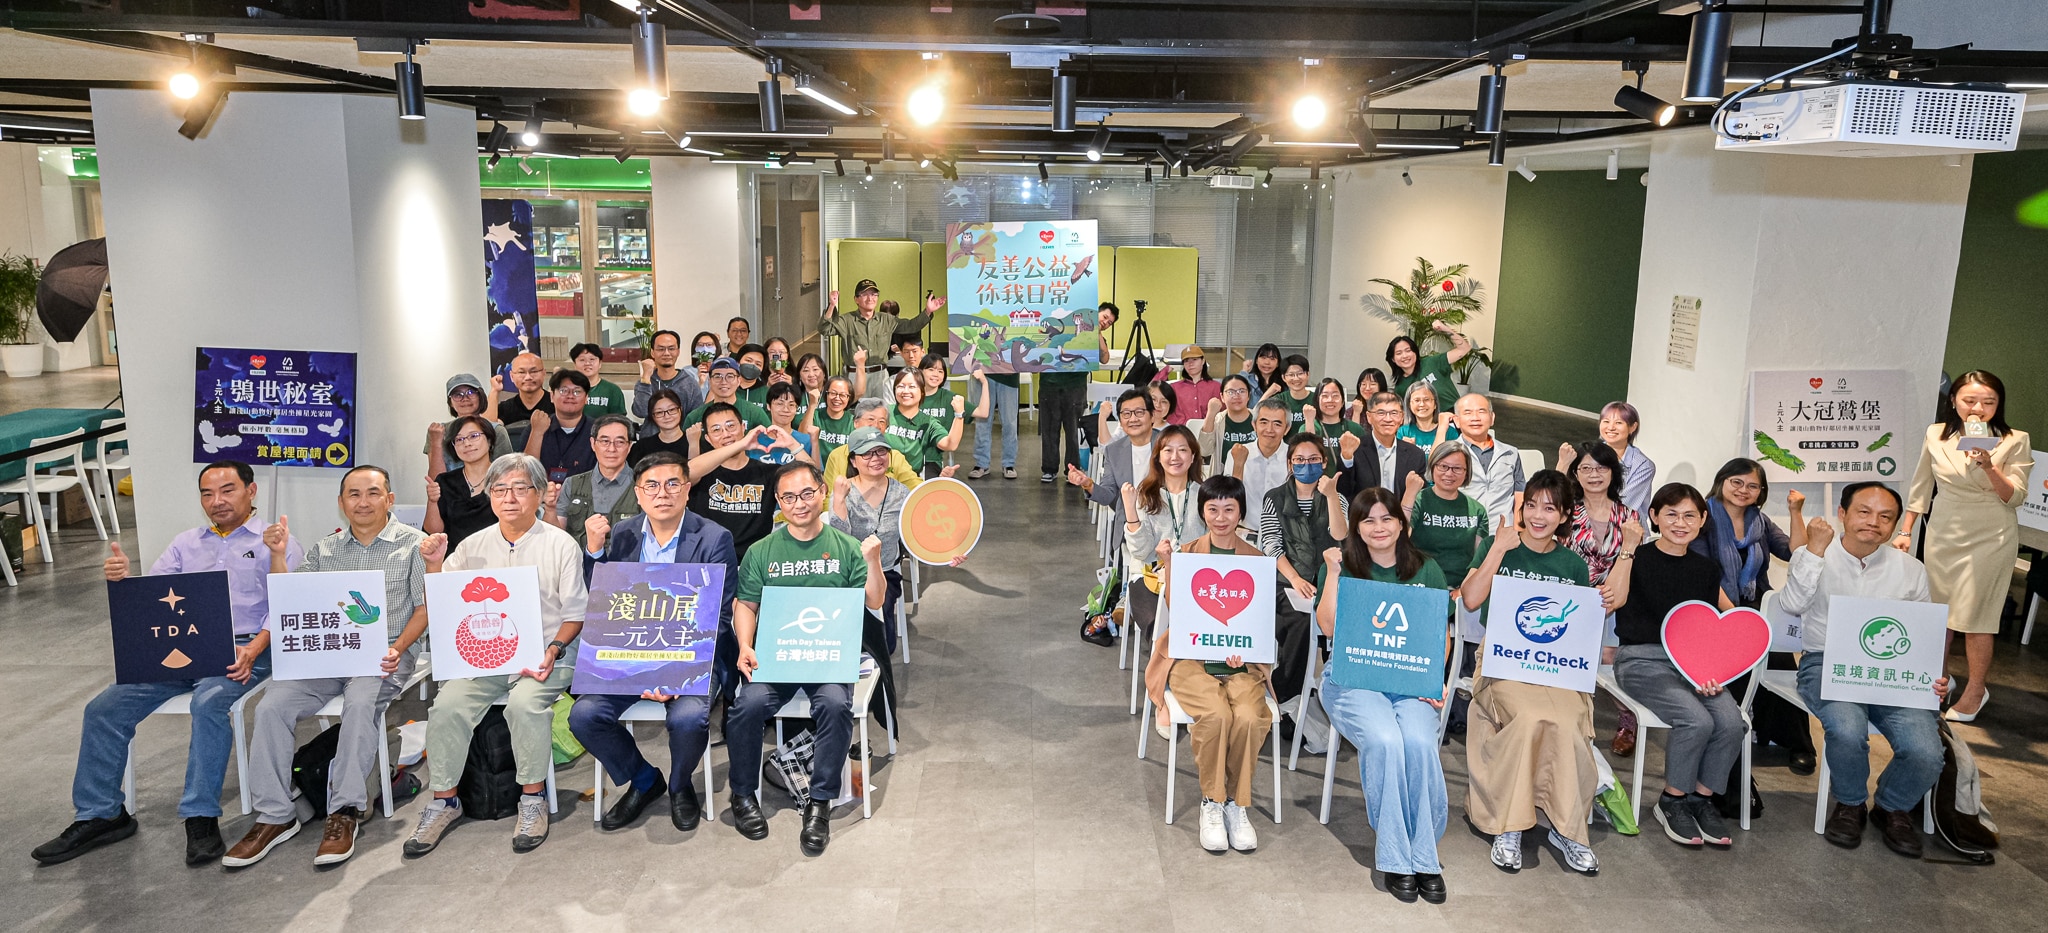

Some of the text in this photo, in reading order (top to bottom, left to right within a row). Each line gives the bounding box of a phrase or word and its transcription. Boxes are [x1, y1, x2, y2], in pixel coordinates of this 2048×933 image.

[977, 255, 1071, 281] 友善公益
[976, 281, 1070, 305] 你我日常
[214, 379, 223, 414] 1元入主
[1790, 400, 1881, 421] 大冠鷲堡
[257, 445, 322, 459] 賞屋裡面請
[1816, 461, 1874, 472] 賞屋裡面請
[1432, 514, 1478, 528] 自然環資
[782, 559, 840, 576] 自然環資
[1198, 584, 1248, 608] 把愛找回來
[607, 592, 699, 621] 淺山居
[151, 624, 199, 638] TDA
[281, 612, 340, 631] 阿里磅
[282, 633, 361, 652] 生態農場
[602, 625, 695, 647] 一元入主
[799, 639, 814, 647] Day
[815, 638, 841, 646] Taiwan
[1372, 632, 1406, 648] TNF
[776, 649, 840, 661] 台灣地球日
[1345, 646, 1431, 665] 自然保育與環境資訊基金會
[1348, 656, 1363, 664] Trust
[1372, 660, 1392, 668] Nature
[1393, 662, 1428, 673] Foundation
[1493, 644, 1589, 670] Reef Check
[1520, 662, 1559, 674] TAIWAN
[1832, 664, 1932, 685] 環境資訊中心
[1831, 678, 1873, 687] Environmental
[1874, 682, 1909, 690] Information
